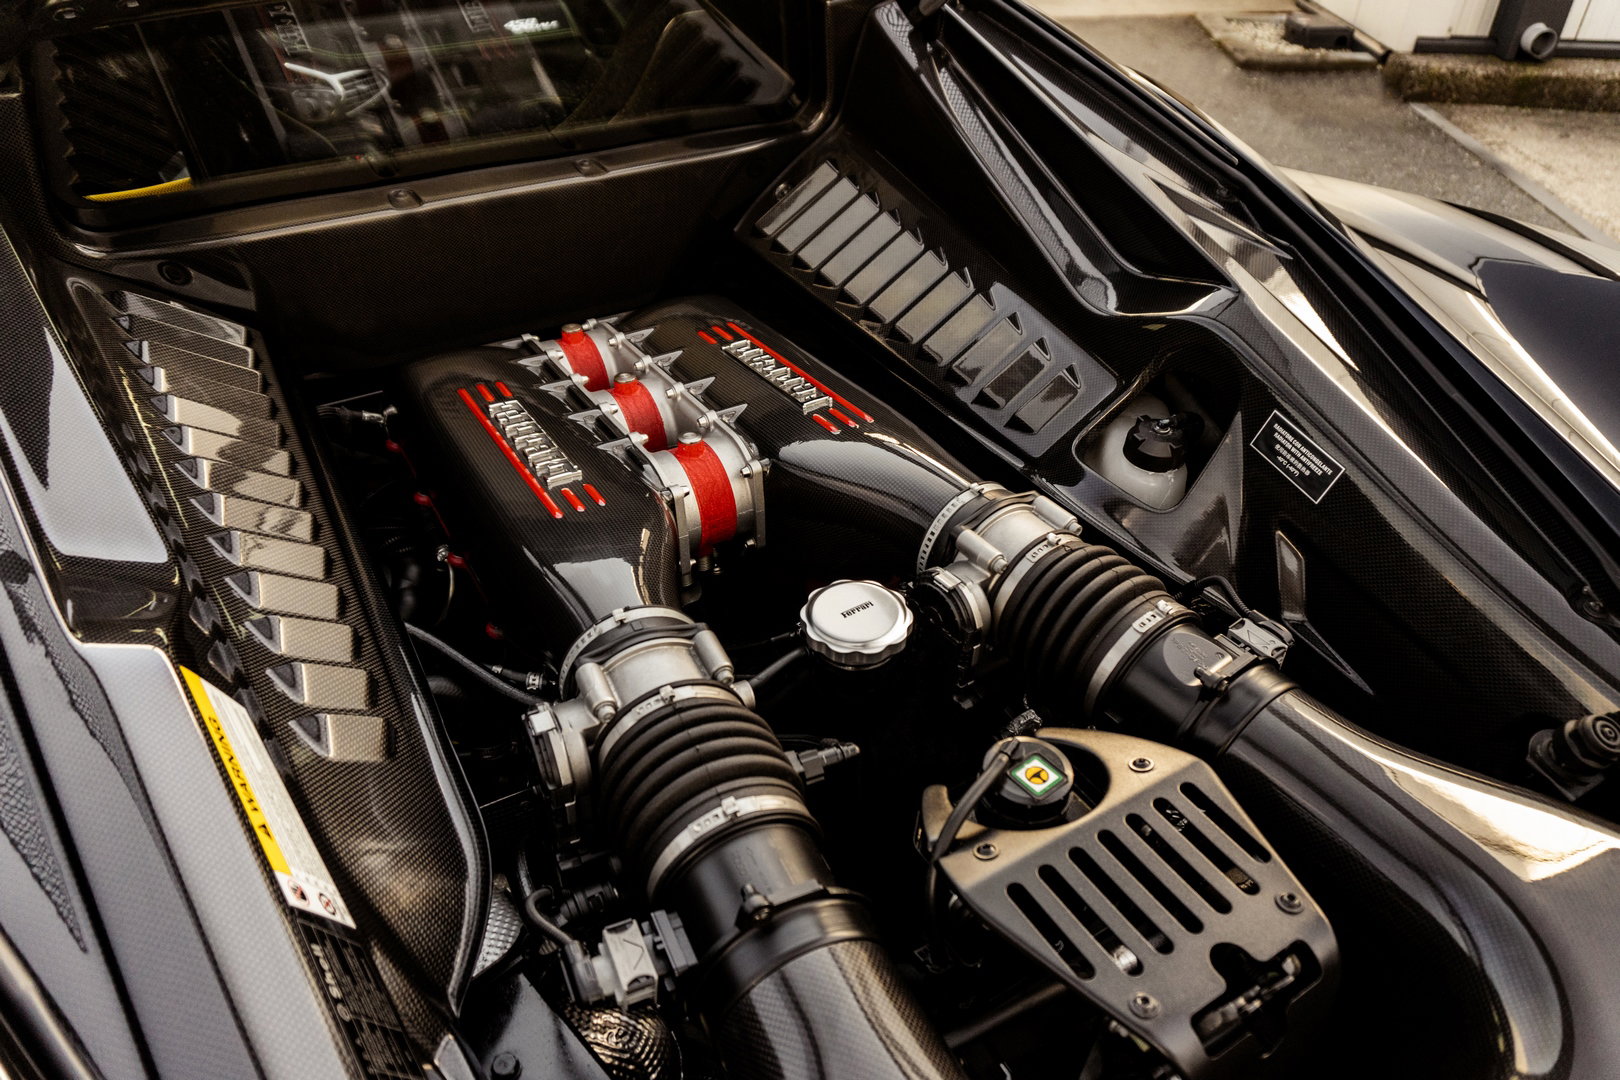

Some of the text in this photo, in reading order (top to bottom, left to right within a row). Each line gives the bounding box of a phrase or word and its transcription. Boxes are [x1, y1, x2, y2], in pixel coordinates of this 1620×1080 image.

[1273, 423, 1294, 442] RADIATORE
[1292, 439, 1302, 448] CON
[1274, 432, 1323, 475] RADIATOR WITH ANTIFREEZE
[840, 600, 874, 619] Ferrari
[208, 716, 260, 813] WARNING
